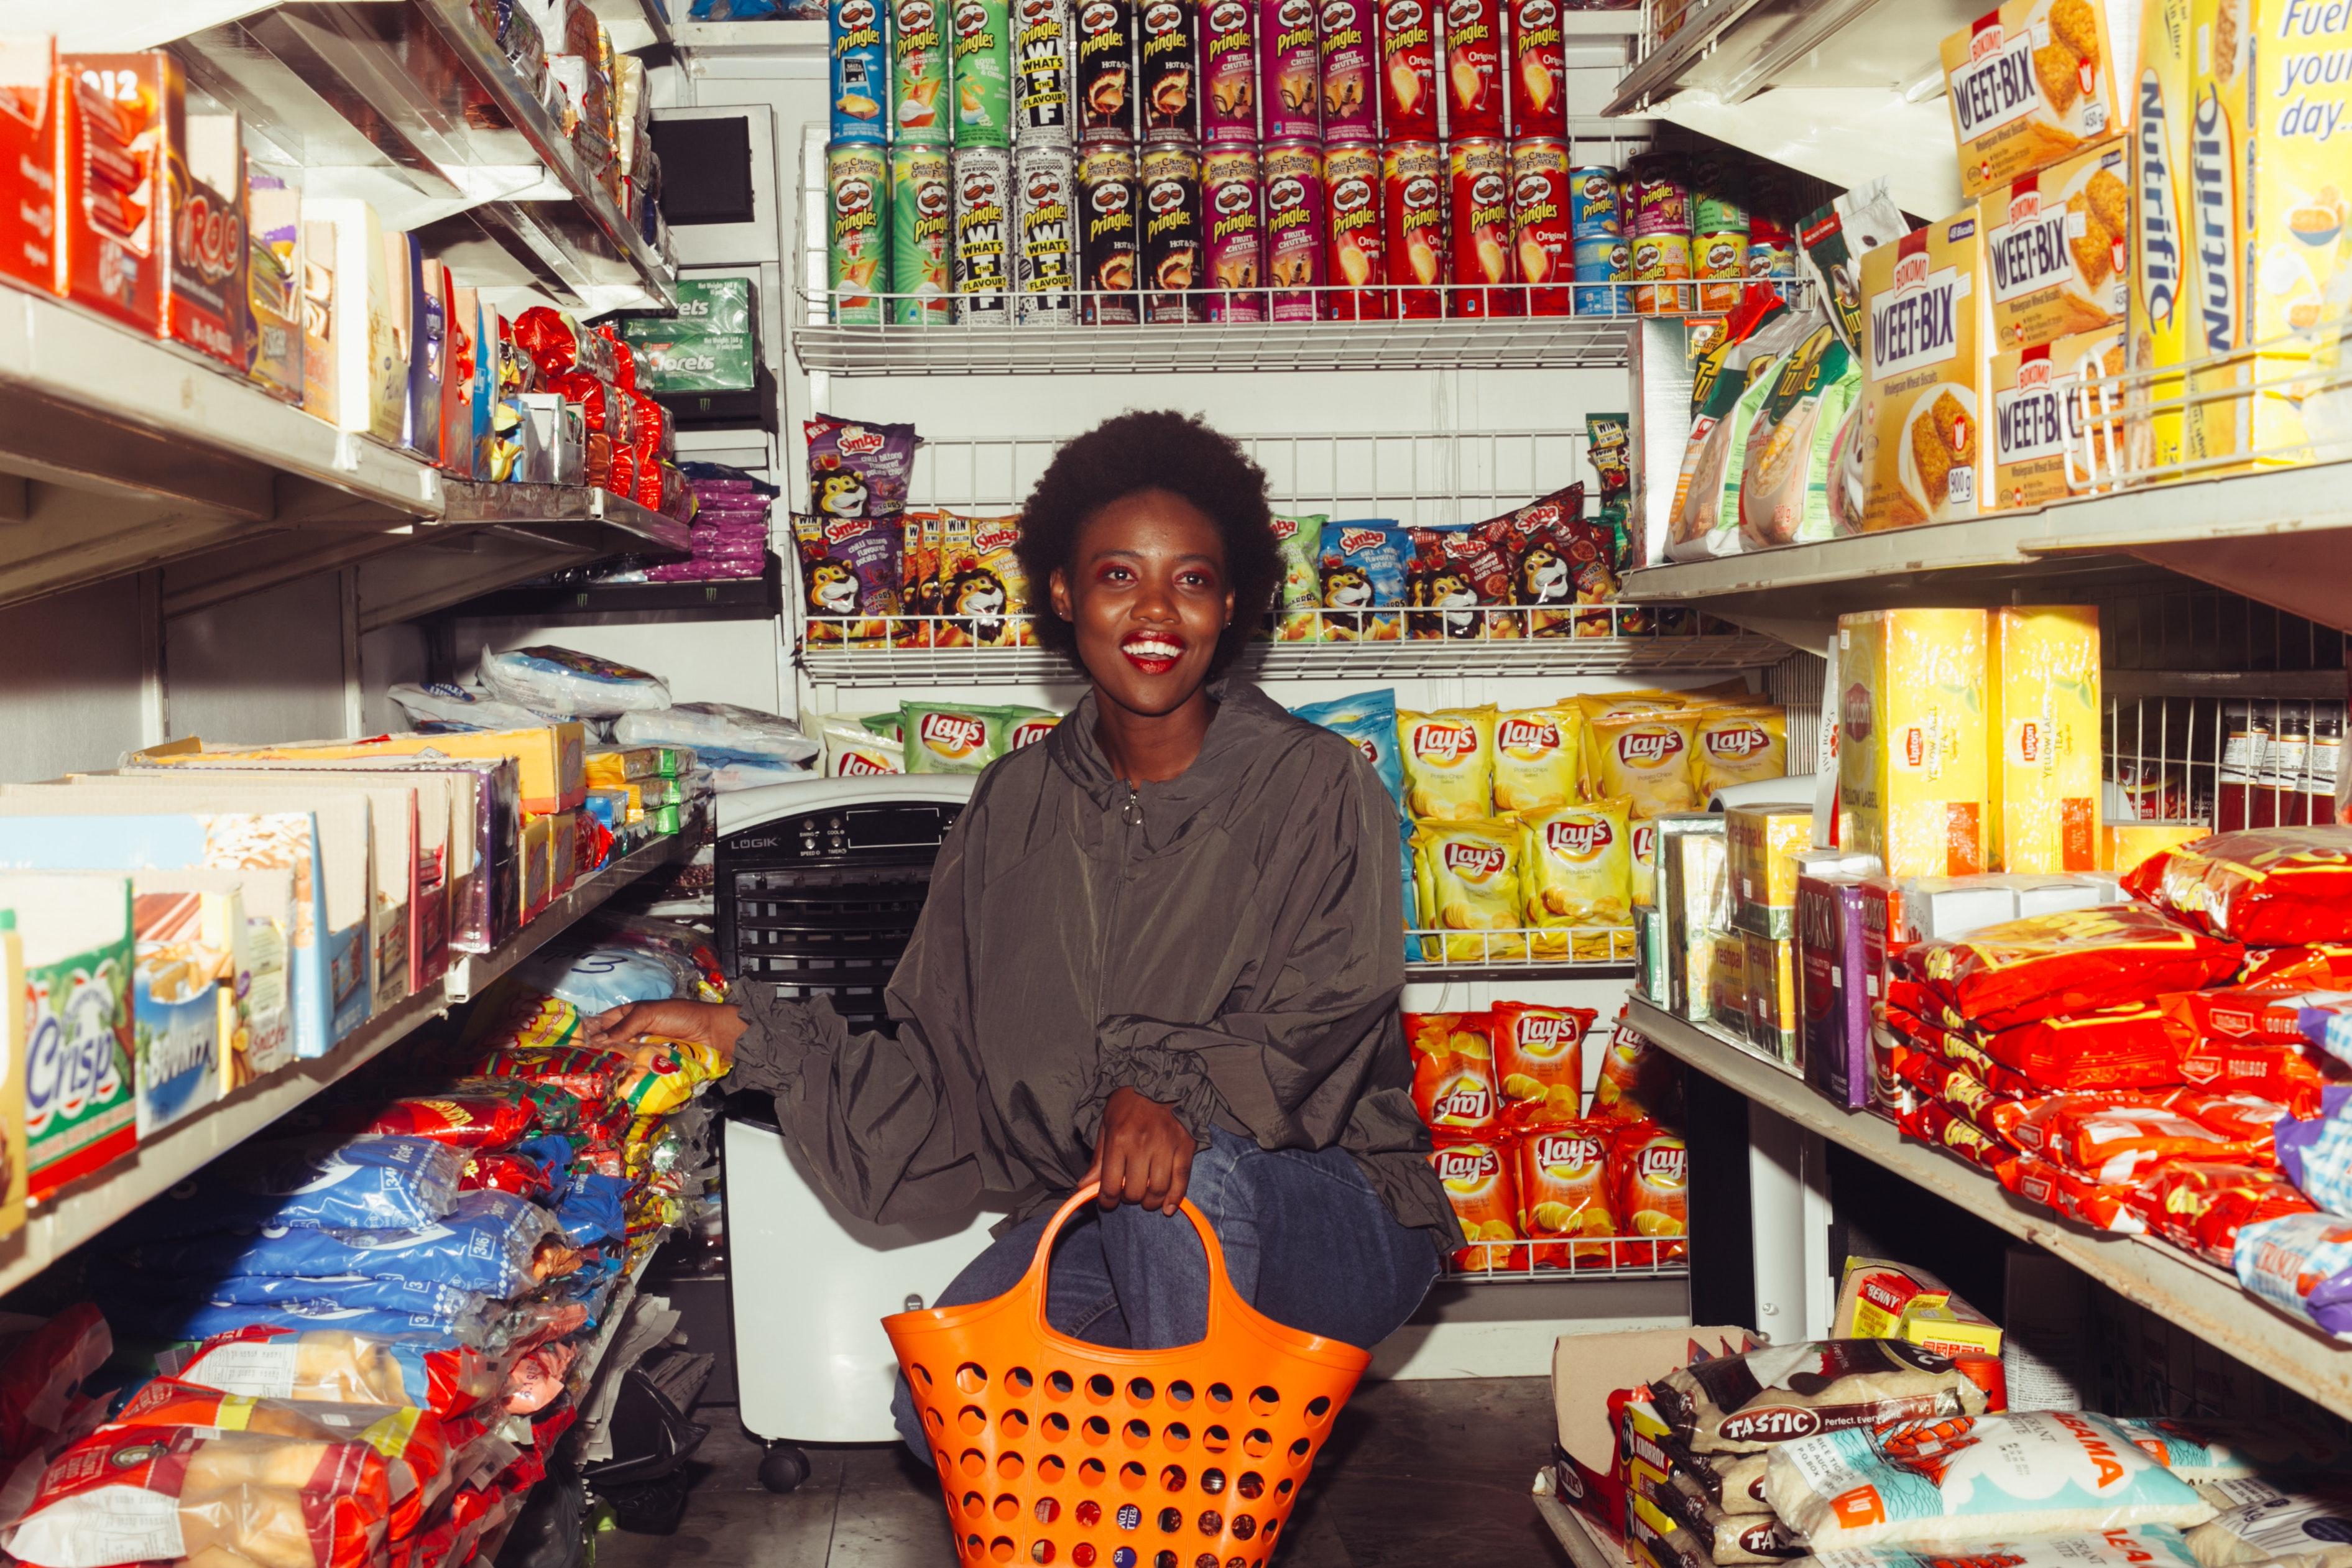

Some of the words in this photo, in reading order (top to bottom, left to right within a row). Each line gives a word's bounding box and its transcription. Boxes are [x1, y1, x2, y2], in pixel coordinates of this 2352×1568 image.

[836, 29, 880, 58] Pringles
[897, 30, 939, 62] Pringles
[955, 33, 994, 62] Pringles
[1019, 22, 1063, 55] Pringles
[1081, 29, 1123, 64] Pringles
[1144, 29, 1187, 64] Pringles
[1209, 31, 1251, 63] Pringles
[1322, 29, 1362, 62] Pringles
[1385, 29, 1428, 61] Pringles
[1447, 24, 1488, 57] Pringles
[1519, 29, 1561, 61] Pringles
[1022, 58, 1064, 74] WHAT'S
[1227, 53, 1248, 62] FRUIT
[1330, 56, 1365, 71] CHUTNEY
[1334, 50, 1357, 61] FRUIT
[1023, 93, 1068, 108] FLAVOUR?
[1953, 46, 2036, 132] WEET-BIX
[1582, 199, 1613, 223] Pringles
[1640, 185, 1674, 208] Pringles
[2142, 82, 2177, 334] Nutrific
[836, 210, 877, 243] Pringles
[960, 200, 1003, 237] Pringles
[1025, 200, 1068, 236] Pringles
[1090, 210, 1132, 242] Pringles
[1148, 210, 1190, 243] Pringles
[1214, 211, 1257, 244] Pringles
[1269, 206, 1310, 240] Pringles
[1333, 208, 1375, 242] Pringles
[1516, 202, 1557, 234] Pringles
[2195, 81, 2232, 353] Nutrific
[962, 240, 1004, 255] WHAT'S
[1028, 239, 1069, 254] WHAT'S
[1231, 234, 1253, 244] FRUIT
[1278, 234, 1312, 249] CHUTNEY
[1283, 229, 1305, 240] FRUIT
[977, 264, 992, 272] THE
[1044, 263, 1057, 272] THE
[1991, 216, 2069, 290] WEET-BIX
[963, 276, 1007, 292] FLAVOUR?
[1029, 276, 1072, 291] FLAVOUR?
[1896, 260, 1927, 291] BOKOMO
[1873, 284, 1953, 367] WEET-BIX
[808, 423, 830, 439] NEW
[839, 431, 883, 454] Simba
[1598, 422, 1616, 433] WIN
[799, 515, 818, 524] WIN
[826, 519, 872, 541] Simba
[948, 519, 966, 532] WIN
[1516, 505, 1557, 536] Simba
[975, 530, 1020, 553] Simba
[1341, 530, 1384, 554] Simba
[1444, 538, 1487, 560] Simba
[924, 713, 983, 750] Lay's
[1417, 724, 1476, 760] Lay's
[1501, 719, 1558, 755] Lay's
[1623, 731, 1679, 761] Lay's
[1711, 727, 1766, 755] Lay's
[2024, 725, 2037, 761] Lipton
[1907, 730, 1921, 765] Lipton
[2042, 742, 2052, 779] YELLOW
[732, 836, 778, 850] LOGIK
[1551, 819, 1610, 854] Lay's
[1449, 844, 1504, 880] Lay's
[1520, 1015, 1573, 1049] Lay's
[1439, 1151, 1495, 1185] Lay's
[1542, 1137, 1599, 1171] Lay's
[1867, 1283, 1901, 1309] BENNY
[1727, 1411, 1810, 1439] TASTIC
[1825, 1416, 1853, 1427] Perfect.
[1636, 1435, 1665, 1469] KNORROX
[1807, 1442, 1816, 1452] 40
[1815, 1437, 1832, 1456] RICE
